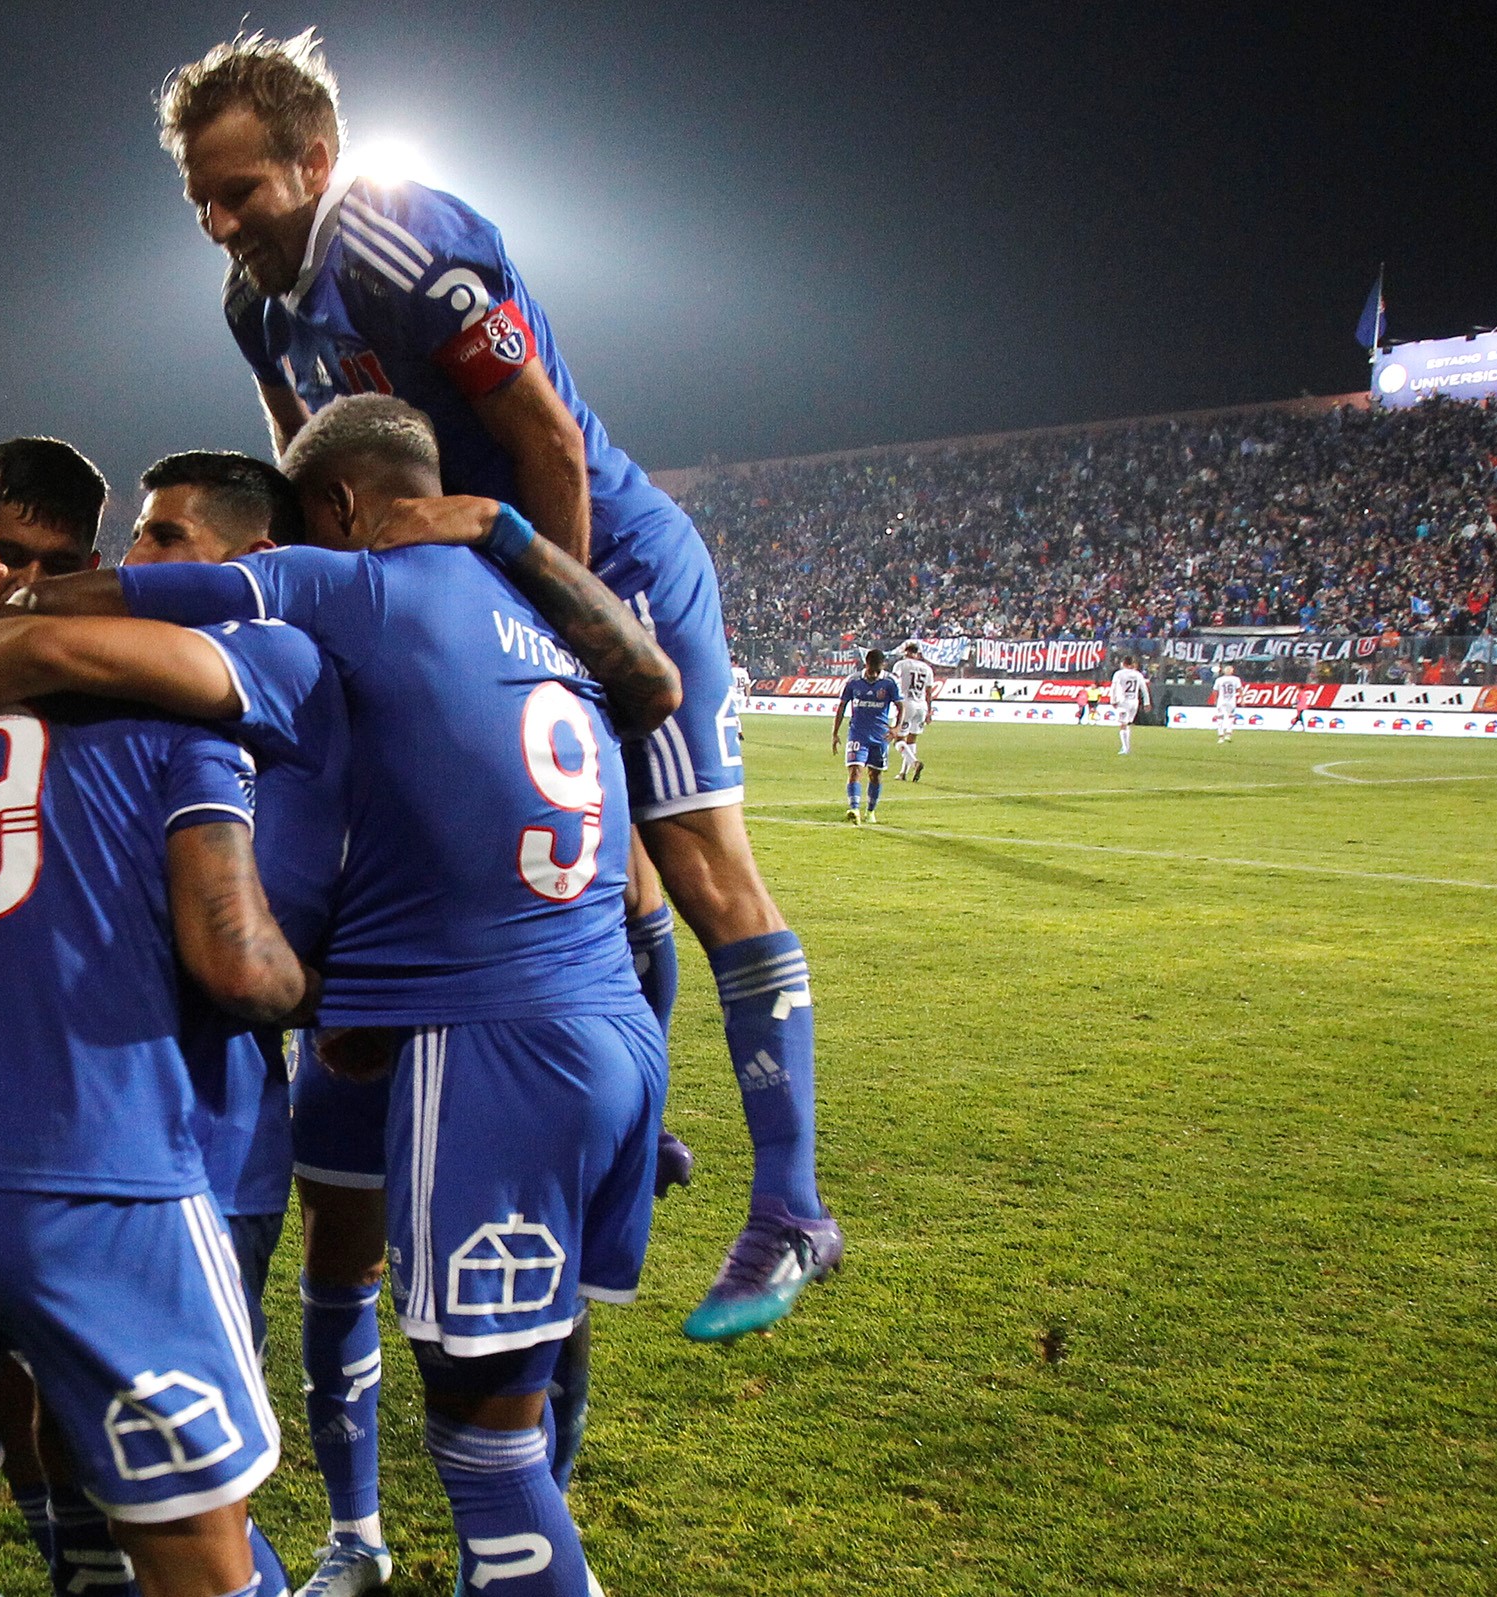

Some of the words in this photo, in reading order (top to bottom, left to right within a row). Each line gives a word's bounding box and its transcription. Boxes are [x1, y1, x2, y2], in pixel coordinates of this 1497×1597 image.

[460, 338, 489, 362] CHILE
[1426, 352, 1482, 370] ESTADIO
[975, 638, 1045, 673] DIRIGENTES
[1045, 640, 1103, 673] INEPTOS
[1162, 639, 1208, 663] ASUL
[1321, 640, 1352, 661] LA
[909, 672, 926, 691] 15
[1125, 680, 1138, 693] 21
[516, 679, 605, 904] 9
